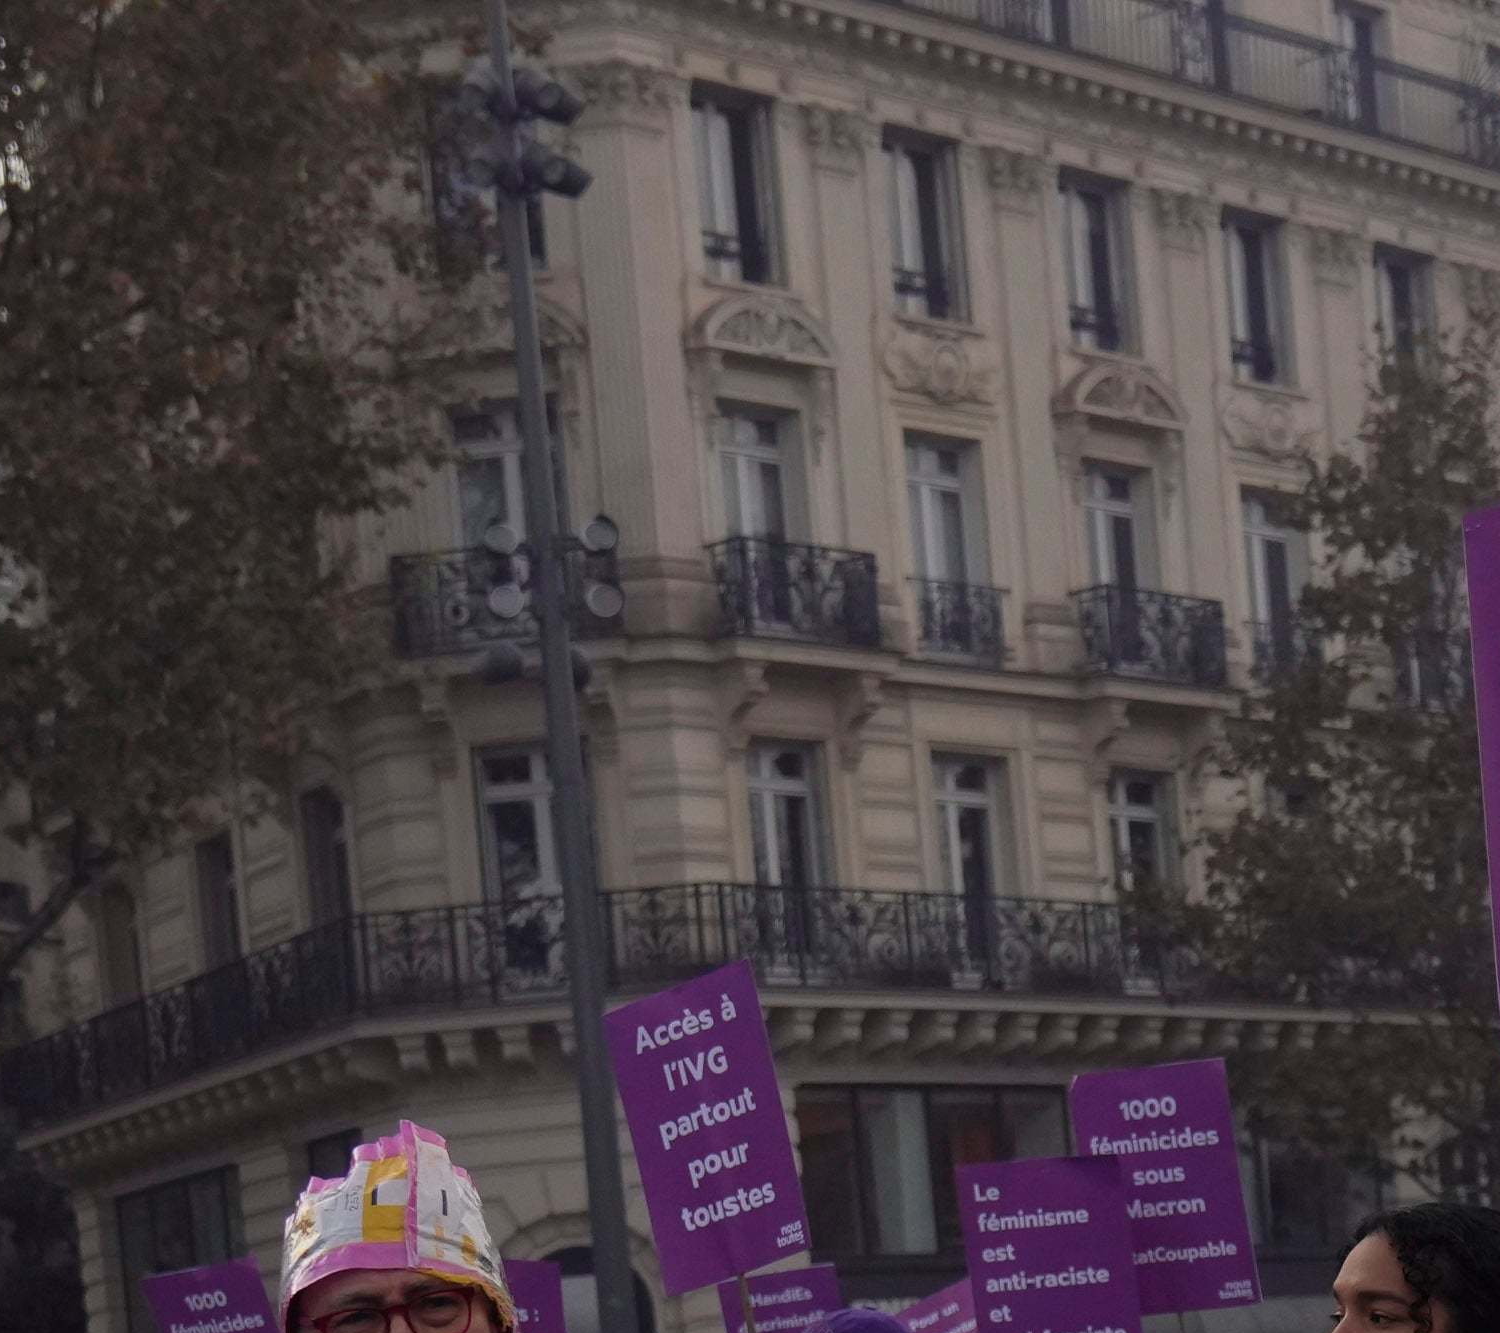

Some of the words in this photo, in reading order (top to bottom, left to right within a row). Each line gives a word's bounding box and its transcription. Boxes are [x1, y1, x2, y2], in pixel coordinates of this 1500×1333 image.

[636, 1008, 714, 1055] Accès
[720, 993, 737, 1022] à
[663, 1046, 729, 1092] l'IVG
[659, 1087, 757, 1151] partout
[1118, 1096, 1177, 1121] 1000
[1089, 1126, 1220, 1155] féminicides
[688, 1142, 750, 1189] pour
[1132, 1166, 1186, 1187] sous
[973, 1183, 1000, 1203] Le
[681, 1182, 776, 1232] toustes
[780, 1220, 802, 1236] nous
[977, 1208, 1090, 1233] féminisme
[776, 1231, 805, 1249] toutes
[981, 1244, 1016, 1263] est
[985, 1266, 1110, 1294] anti-raciste
[184, 1290, 227, 1312] 1000
[989, 1305, 1013, 1323] et
